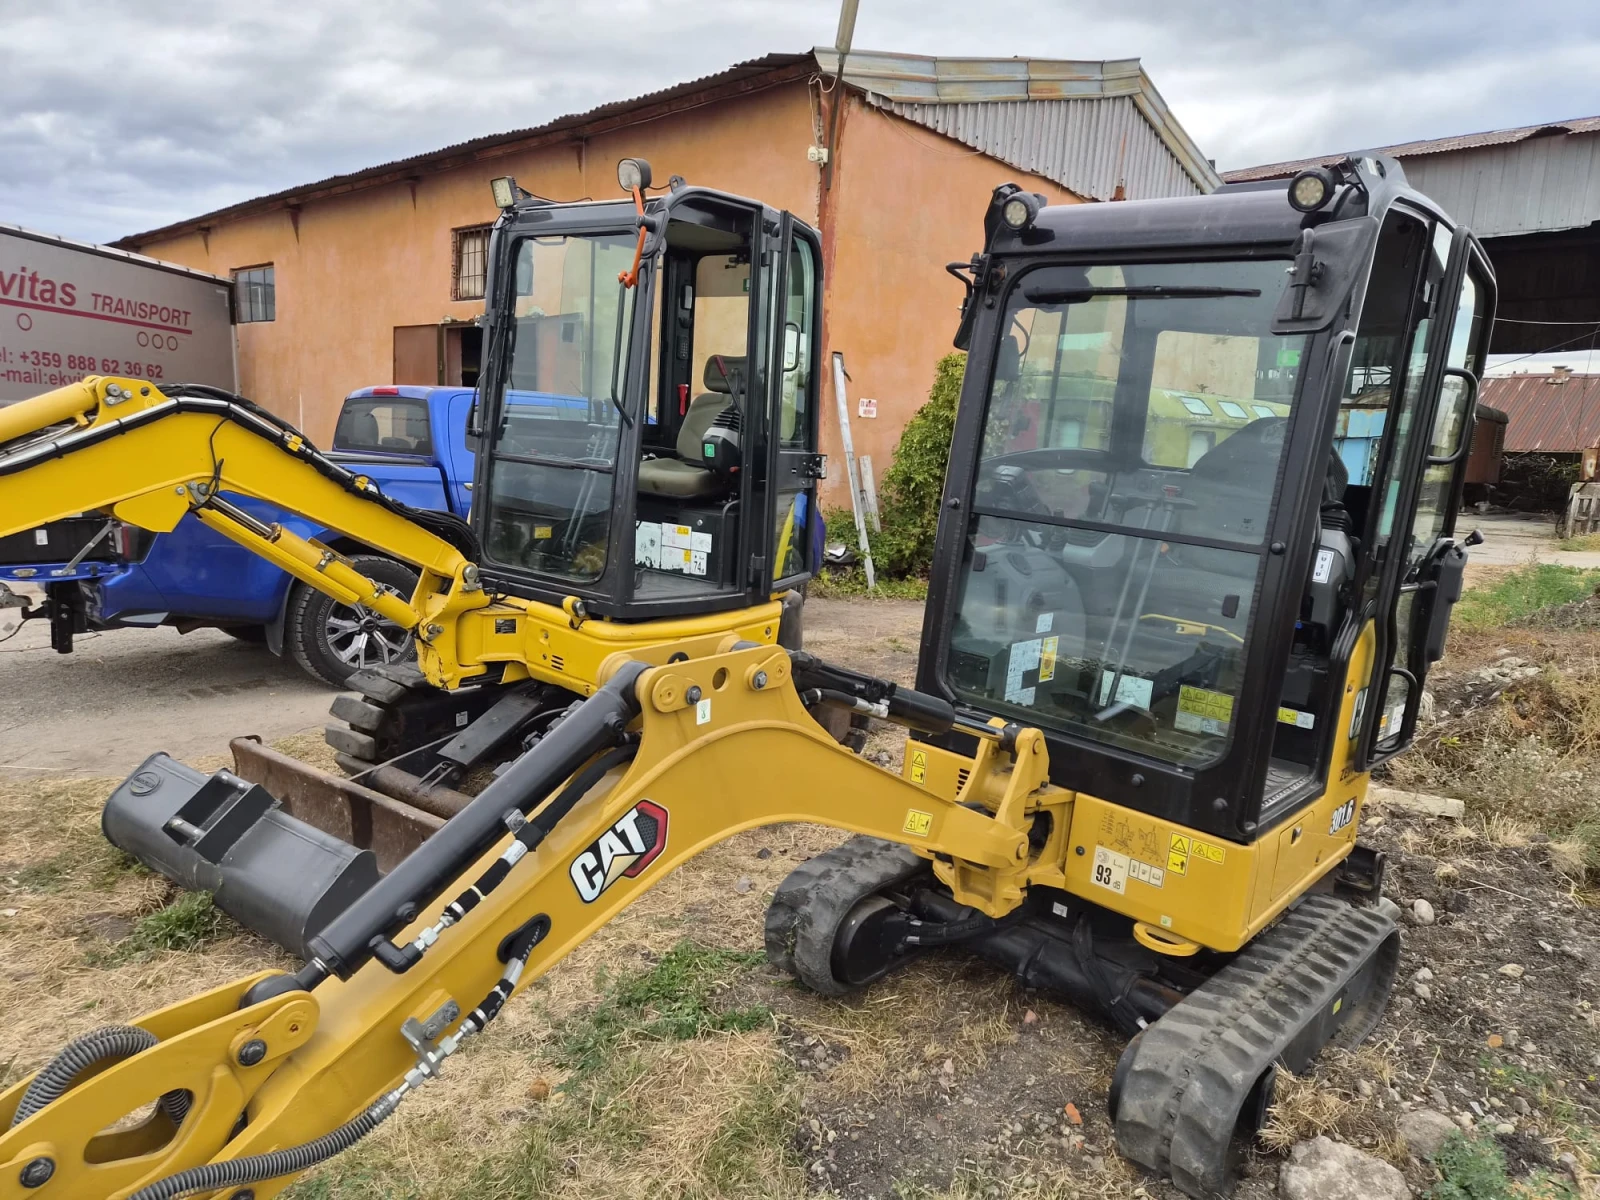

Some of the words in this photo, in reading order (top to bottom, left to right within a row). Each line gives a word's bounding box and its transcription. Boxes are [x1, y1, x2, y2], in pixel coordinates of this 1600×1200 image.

[91, 292, 192, 326] TRANSPORT
[20, 350, 61, 368] +359
[67, 354, 97, 371] 888
[101, 358, 120, 374] 62
[124, 361, 142, 376] 30
[146, 364, 164, 379] 62
[570, 808, 646, 902] CAT
[1095, 864, 1112, 885] 93
